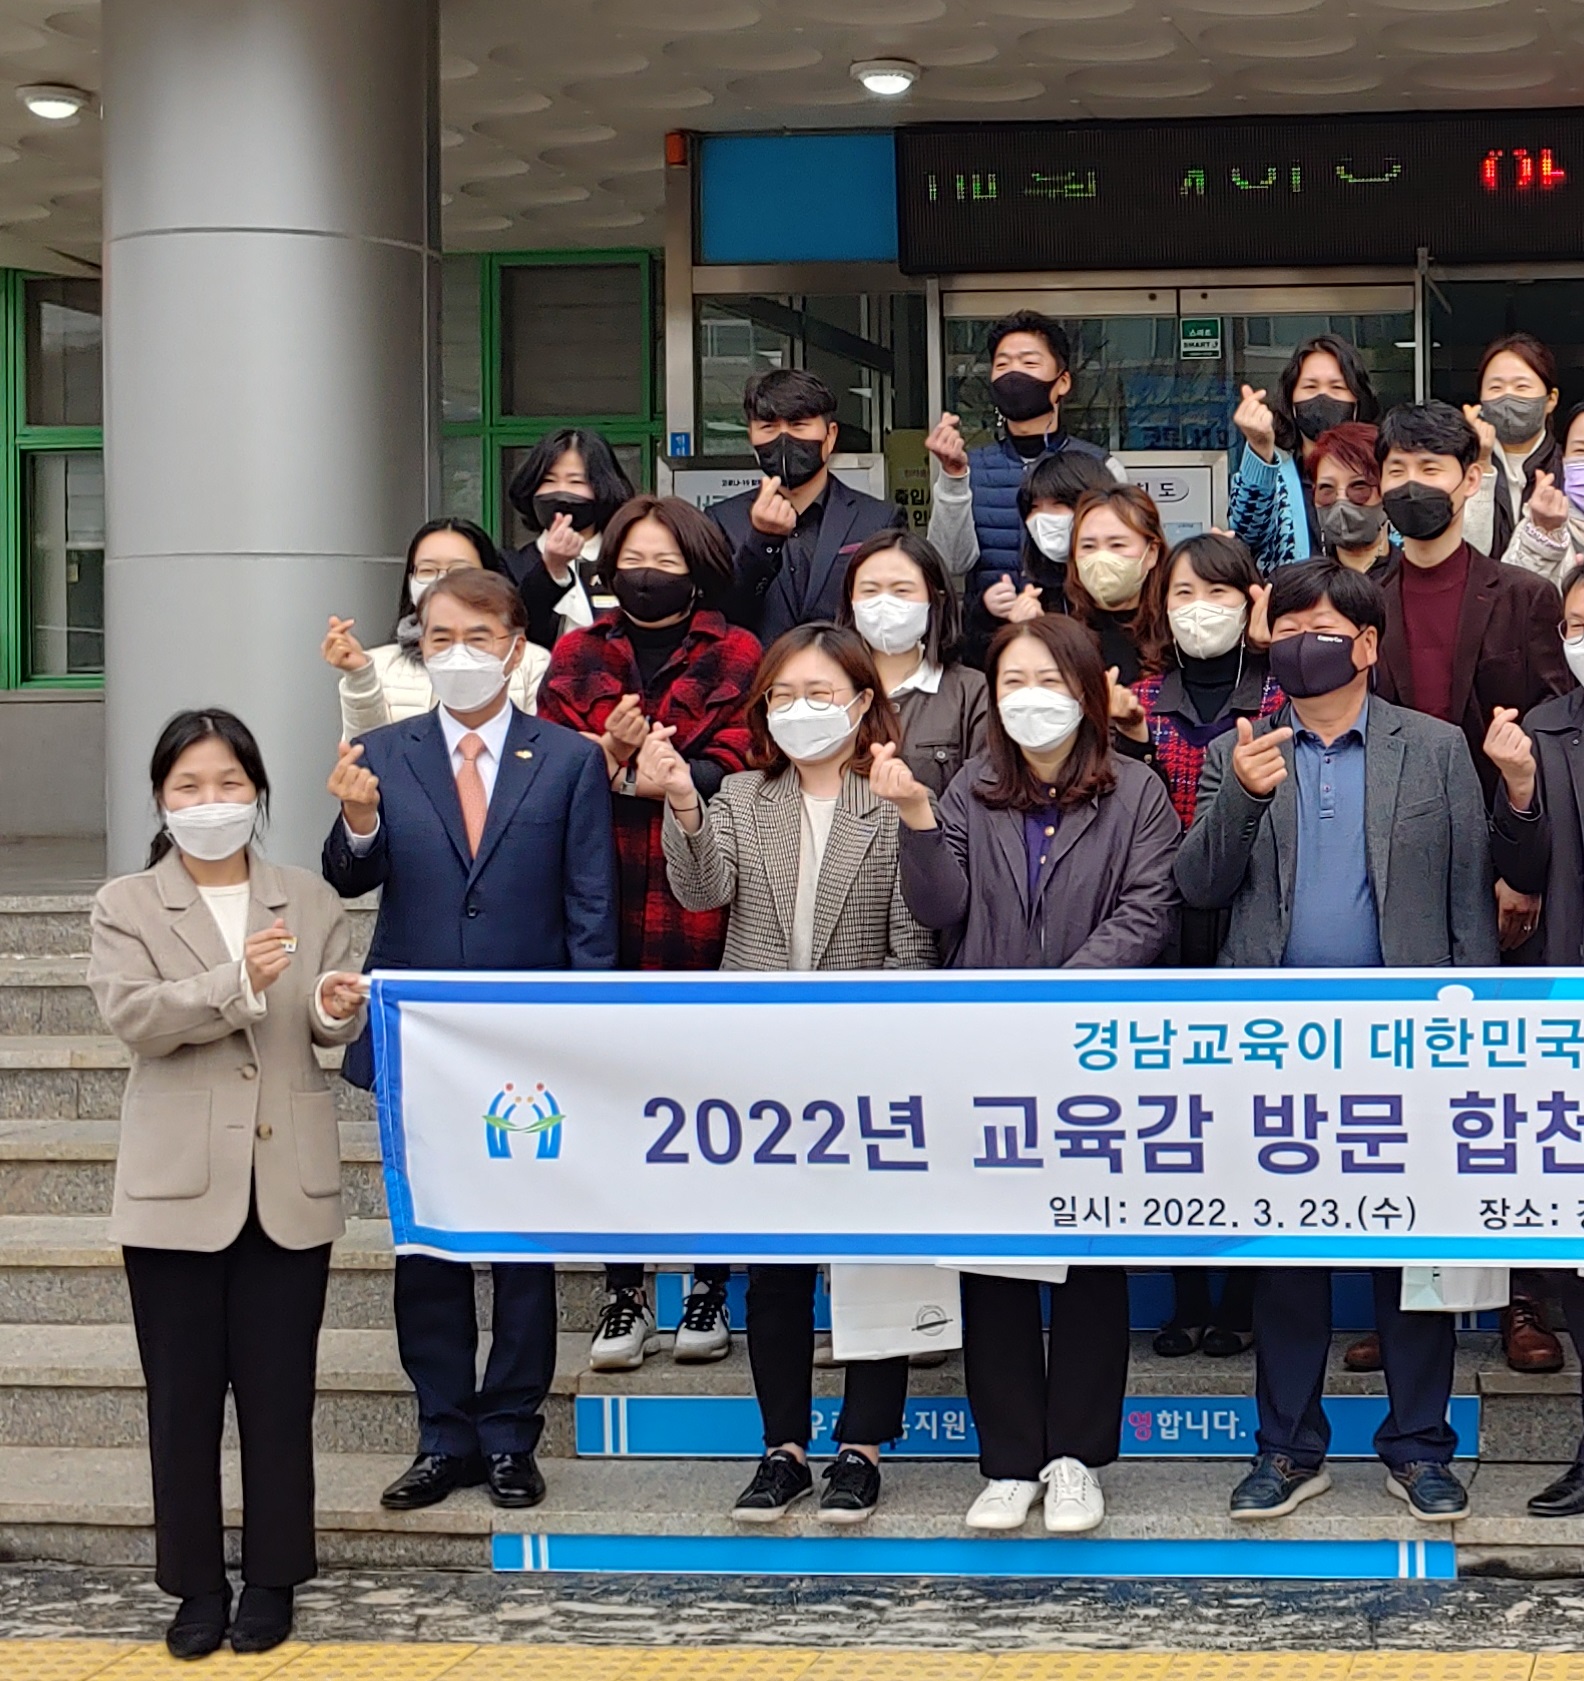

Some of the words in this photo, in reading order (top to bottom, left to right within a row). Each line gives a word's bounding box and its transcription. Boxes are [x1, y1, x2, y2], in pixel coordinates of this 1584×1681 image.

[1073, 1018, 1344, 1071] 경남교육이
[643, 1095, 929, 1172] 2022년
[973, 1094, 1214, 1174] 교육감
[1253, 1093, 1408, 1175] 방문
[1049, 1195, 1126, 1228] 일시:
[1143, 1198, 1238, 1228] 2022.
[1253, 1198, 1284, 1229] 3.
[1299, 1195, 1416, 1232] 23.(수)
[1479, 1197, 1558, 1231] 장소:
[1121, 1409, 1246, 1441] 영합니다.
